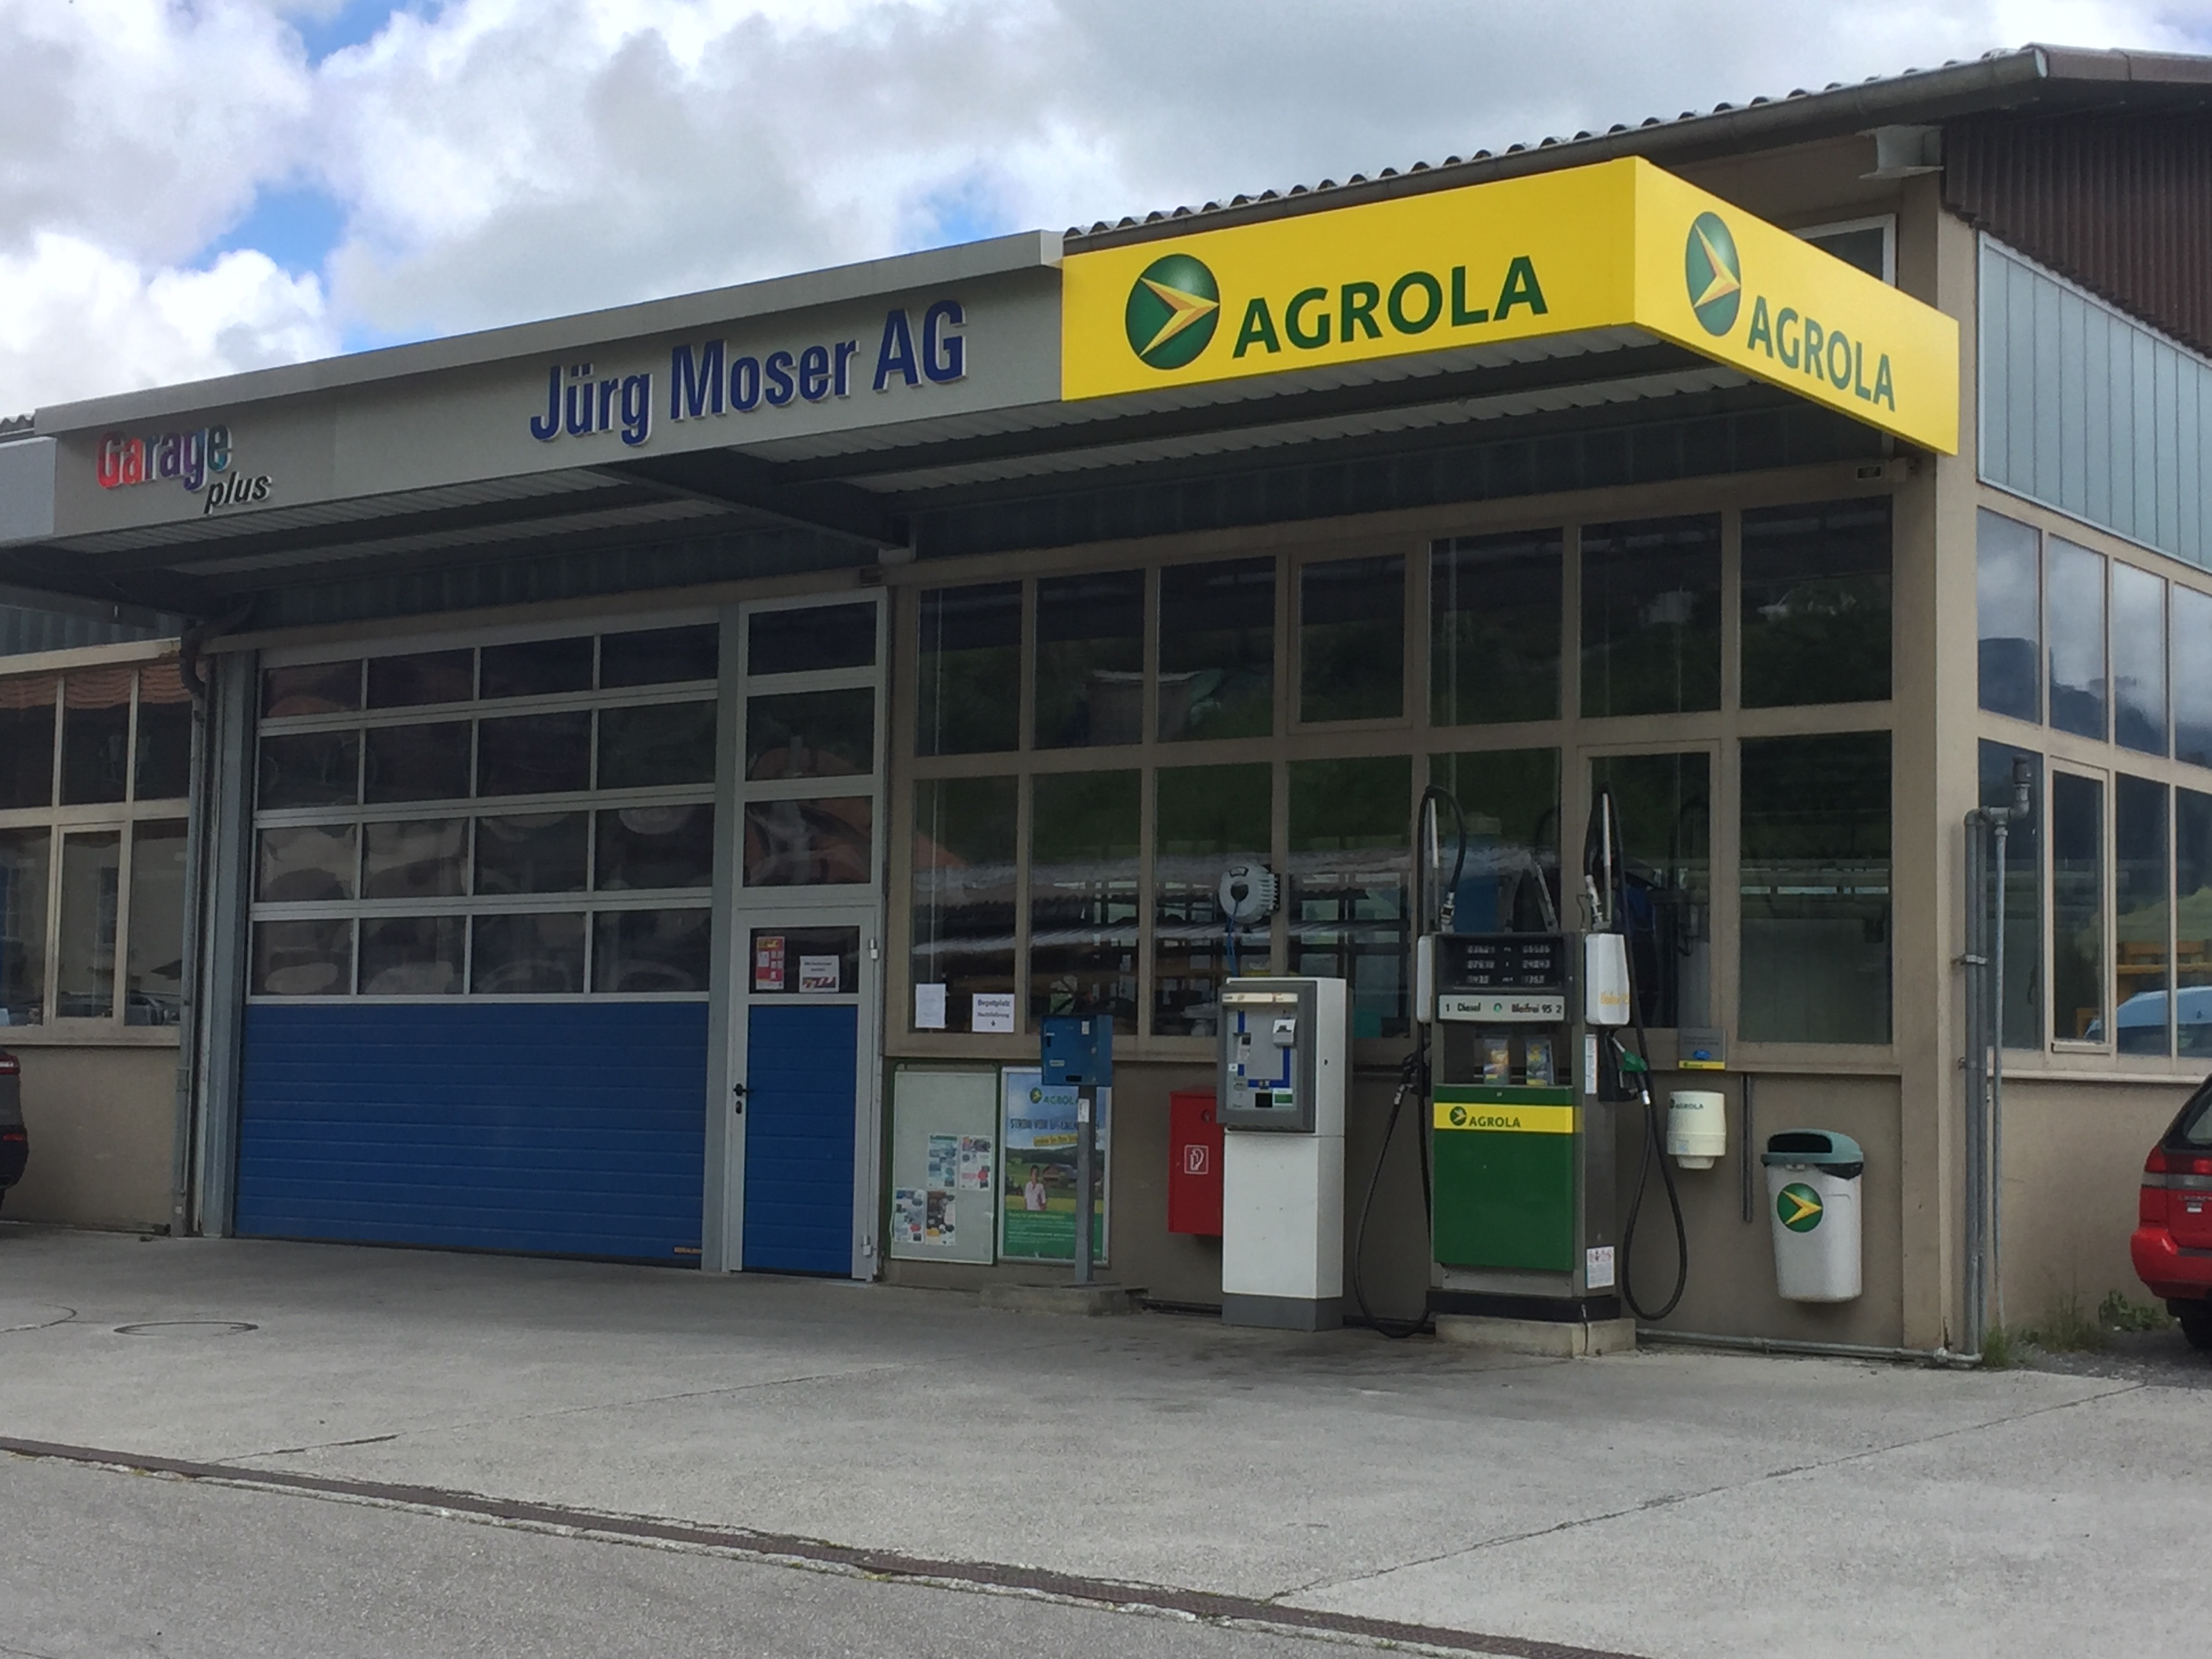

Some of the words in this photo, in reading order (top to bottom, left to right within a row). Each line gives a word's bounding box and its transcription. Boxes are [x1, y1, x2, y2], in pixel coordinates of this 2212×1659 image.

[1232, 255, 1549, 359] AGROLA
[530, 361, 653, 446] Jürg
[670, 339, 859, 423] Moser
[872, 300, 968, 392] AG
[1747, 294, 1896, 412] AGROLA
[96, 424, 233, 491] Garage
[204, 472, 272, 515] plus
[1446, 1004, 1450, 1012] 1
[1457, 1002, 1481, 1012] Diesel
[1542, 1004, 1553, 1014] 95
[1556, 1004, 1562, 1014] 2
[1469, 1115, 1521, 1128] AGROLA
